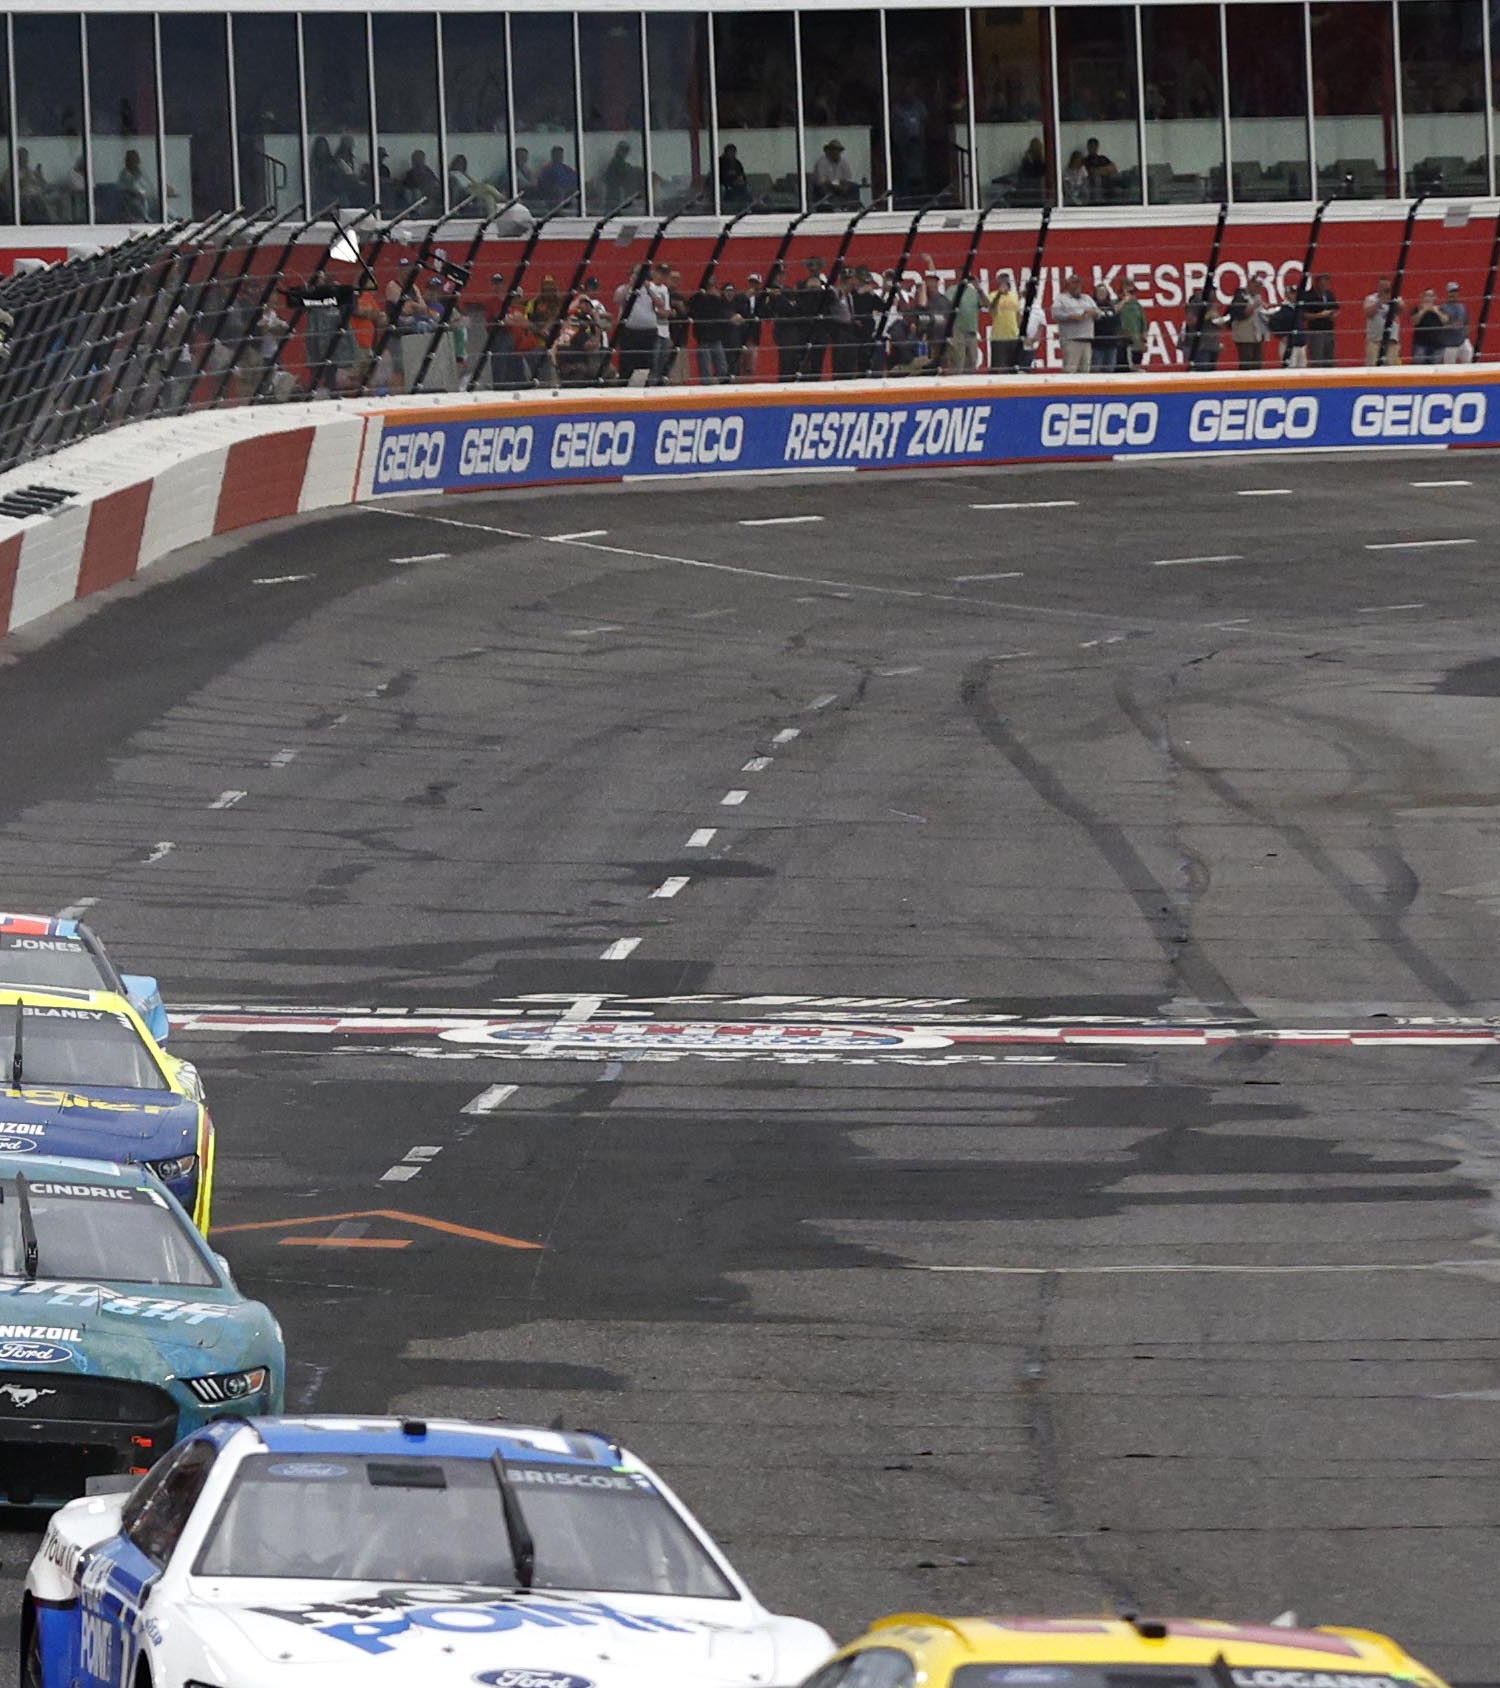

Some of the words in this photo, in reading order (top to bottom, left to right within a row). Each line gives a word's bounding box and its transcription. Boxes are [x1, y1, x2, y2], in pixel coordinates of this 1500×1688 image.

[378, 431, 446, 482] GEICO
[459, 425, 533, 475] GEICO
[550, 420, 635, 469] GEICO
[655, 415, 743, 465] GEICO
[784, 409, 908, 461] RESTART
[906, 406, 992, 457] ZONE
[1040, 401, 1158, 447] GEICO
[1189, 396, 1318, 442] GEICO
[1351, 391, 1486, 437] GEICO
[10, 938, 83, 954] JONES
[22, 1007, 104, 1021] BLANEY
[29, 1183, 133, 1200] CINDRIC
[507, 1469, 634, 1491] BRISCOE
